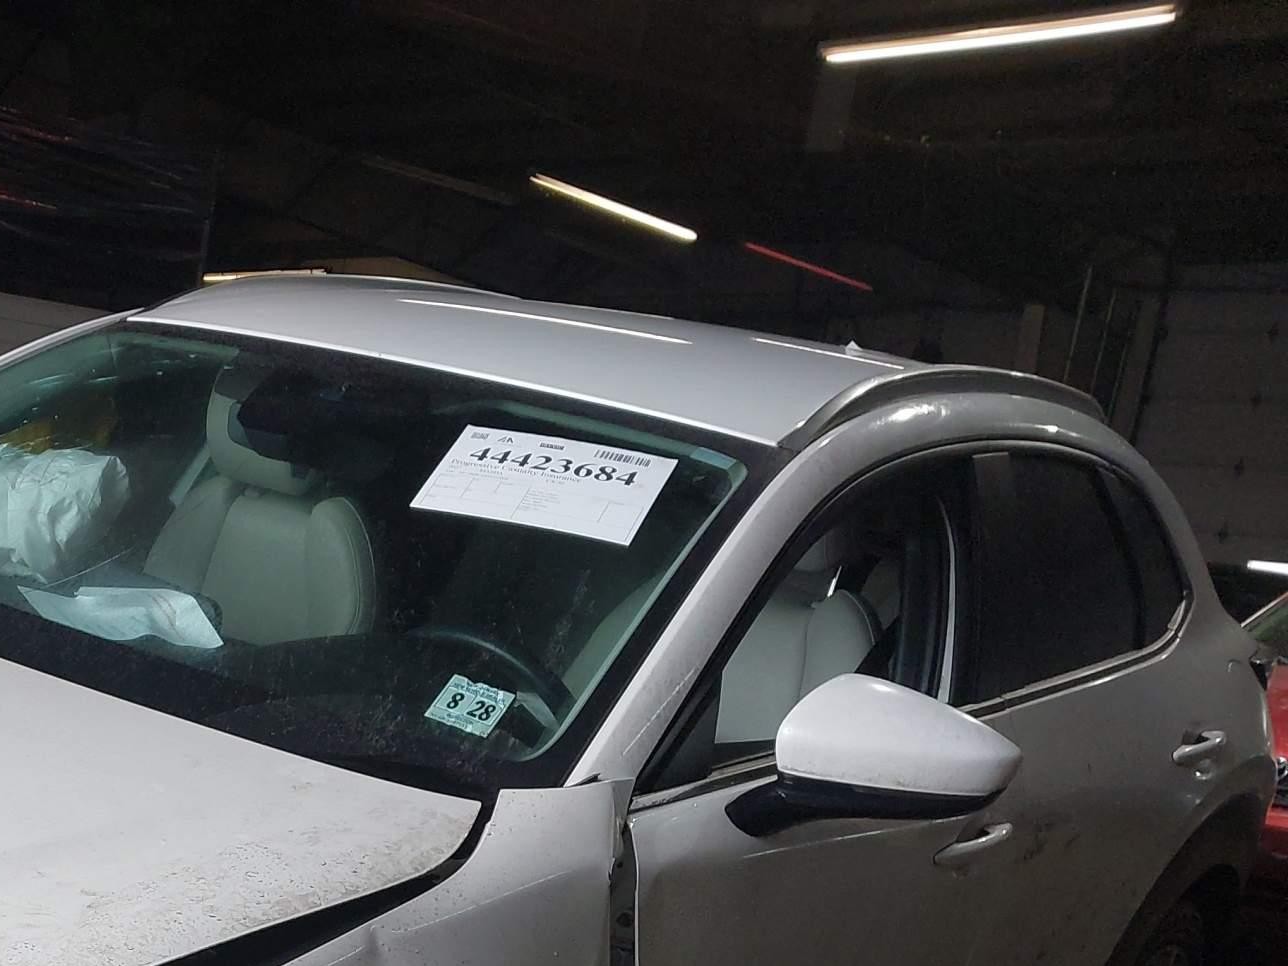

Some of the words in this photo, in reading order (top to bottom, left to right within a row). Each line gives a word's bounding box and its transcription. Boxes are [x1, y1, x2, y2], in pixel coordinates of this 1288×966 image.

[470, 447, 638, 486] 44423684
[446, 692, 465, 710] 8
[466, 700, 496, 721] 28
